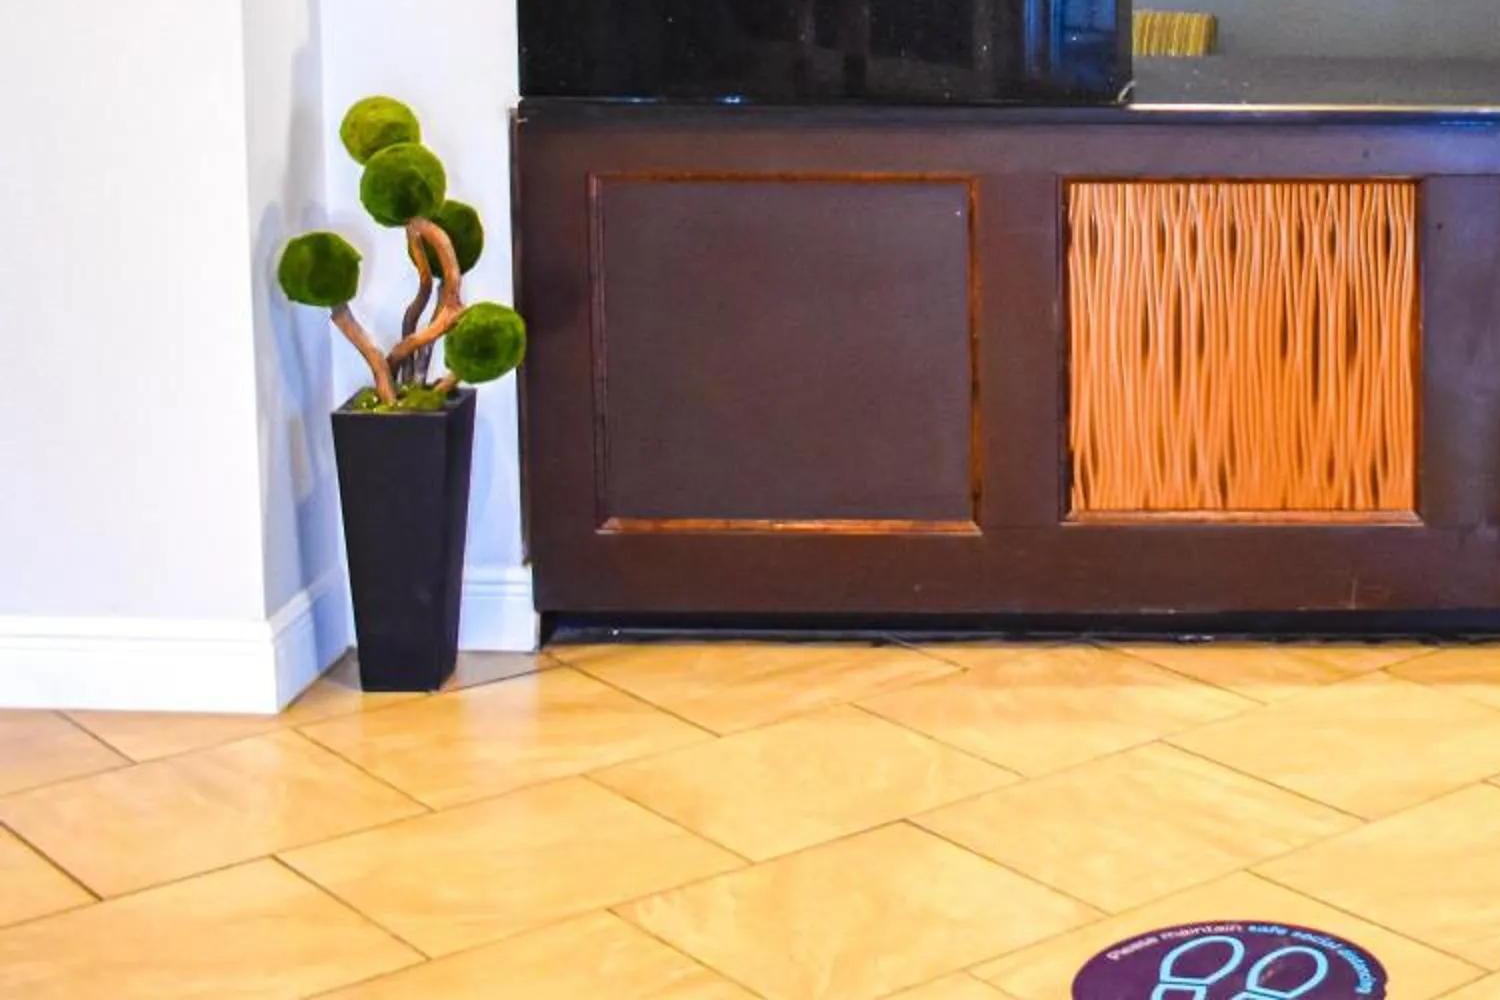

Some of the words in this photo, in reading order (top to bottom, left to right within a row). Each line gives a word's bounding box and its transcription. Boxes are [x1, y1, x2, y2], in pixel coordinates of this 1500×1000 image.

[1105, 936, 1160, 960] Please
[1160, 924, 1243, 940] maintain
[1247, 925, 1289, 935] safe
[1291, 930, 1342, 950] social
